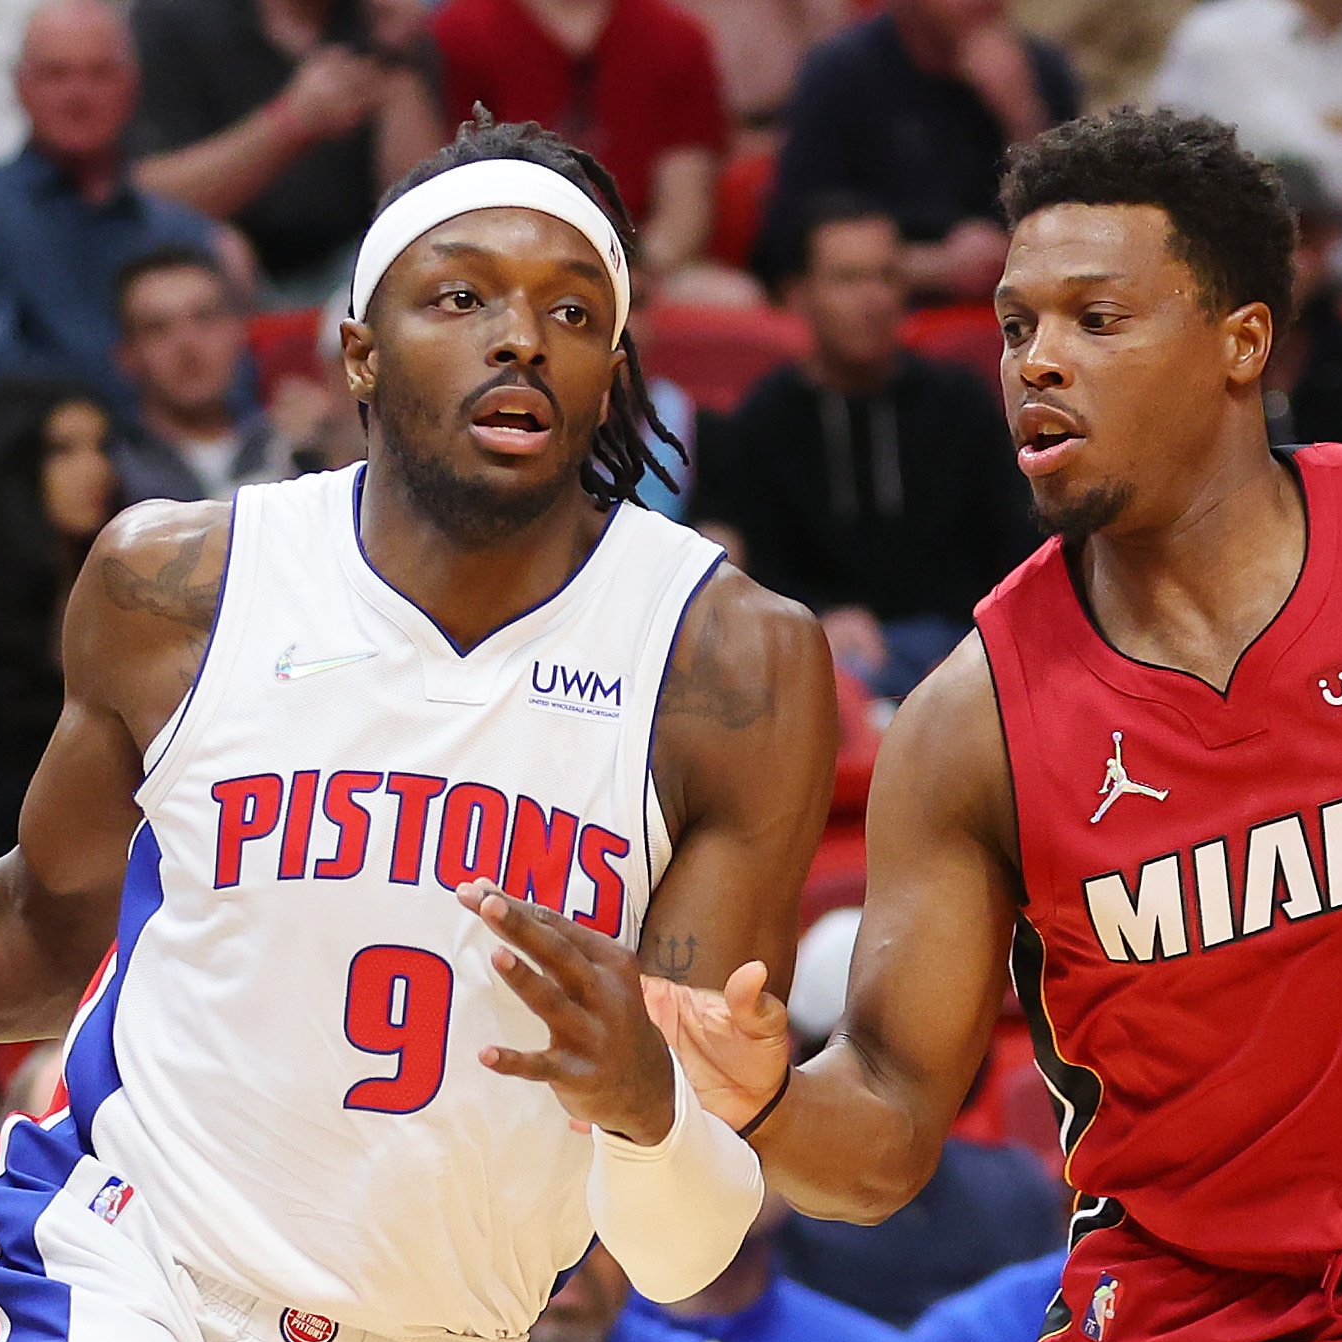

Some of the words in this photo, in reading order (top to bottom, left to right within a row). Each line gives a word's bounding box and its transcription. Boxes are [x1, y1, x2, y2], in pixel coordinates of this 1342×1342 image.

[532, 661, 622, 706] UWM
[529, 698, 549, 707] UNITED
[551, 702, 585, 713] WHOLESALE
[587, 709, 620, 718] MORTGAGE
[211, 768, 630, 938] PISTONS
[343, 943, 455, 1114] 9
[291, 1318, 324, 1340] PISTONS
[297, 1311, 329, 1330] DETROIT
